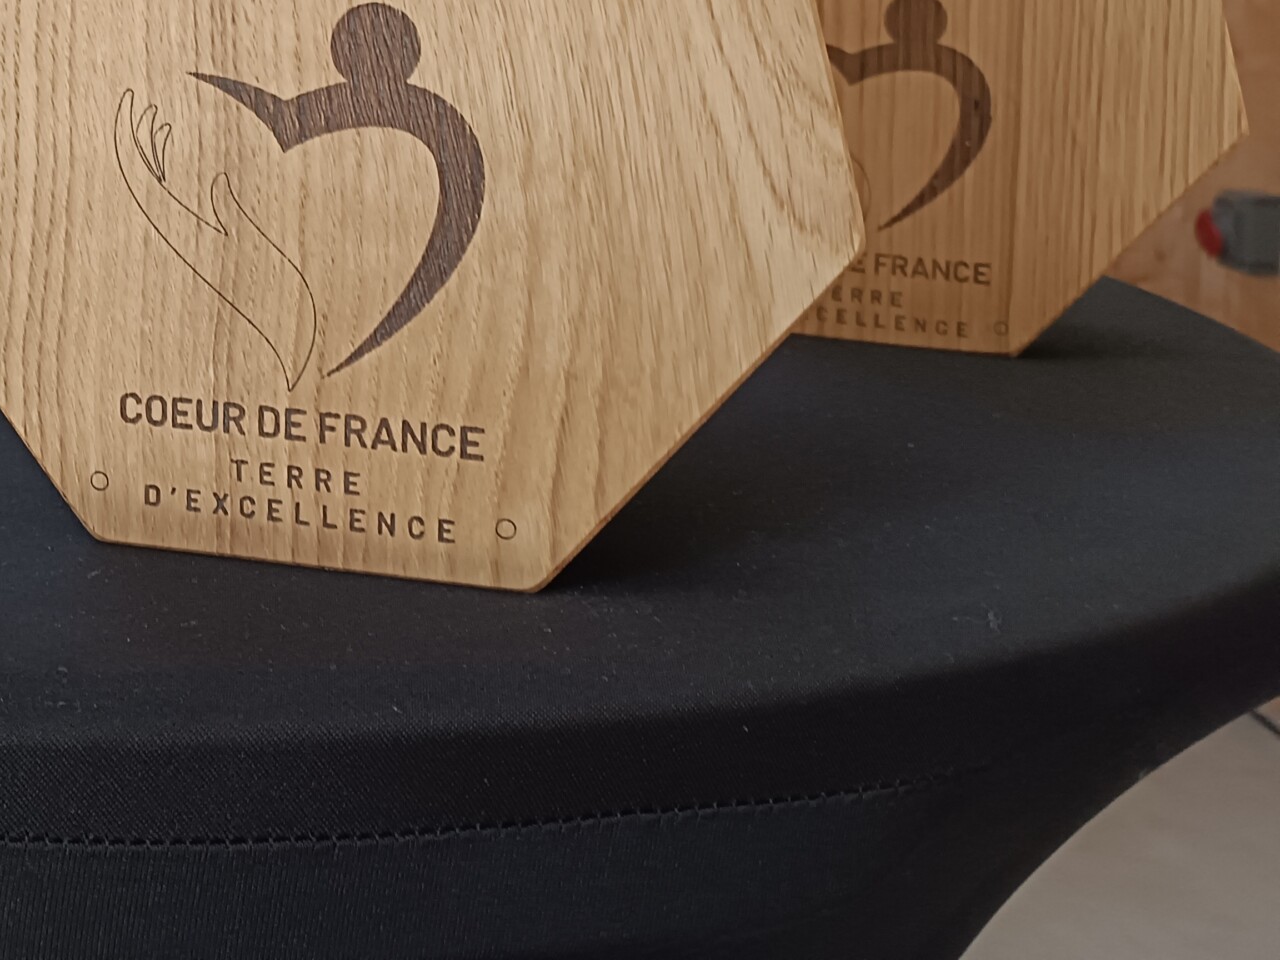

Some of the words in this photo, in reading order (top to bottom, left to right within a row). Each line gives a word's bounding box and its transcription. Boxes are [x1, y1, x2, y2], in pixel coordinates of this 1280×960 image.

[874, 252, 992, 286] FRANCE
[831, 285, 904, 308] ERRE
[815, 305, 969, 338] CELLENCE
[119, 391, 246, 436] COEUR
[257, 404, 308, 443] DE
[318, 411, 486, 461] FRANCE
[230, 457, 362, 497] TERRE
[144, 482, 457, 544] D'EXCELLENCE
